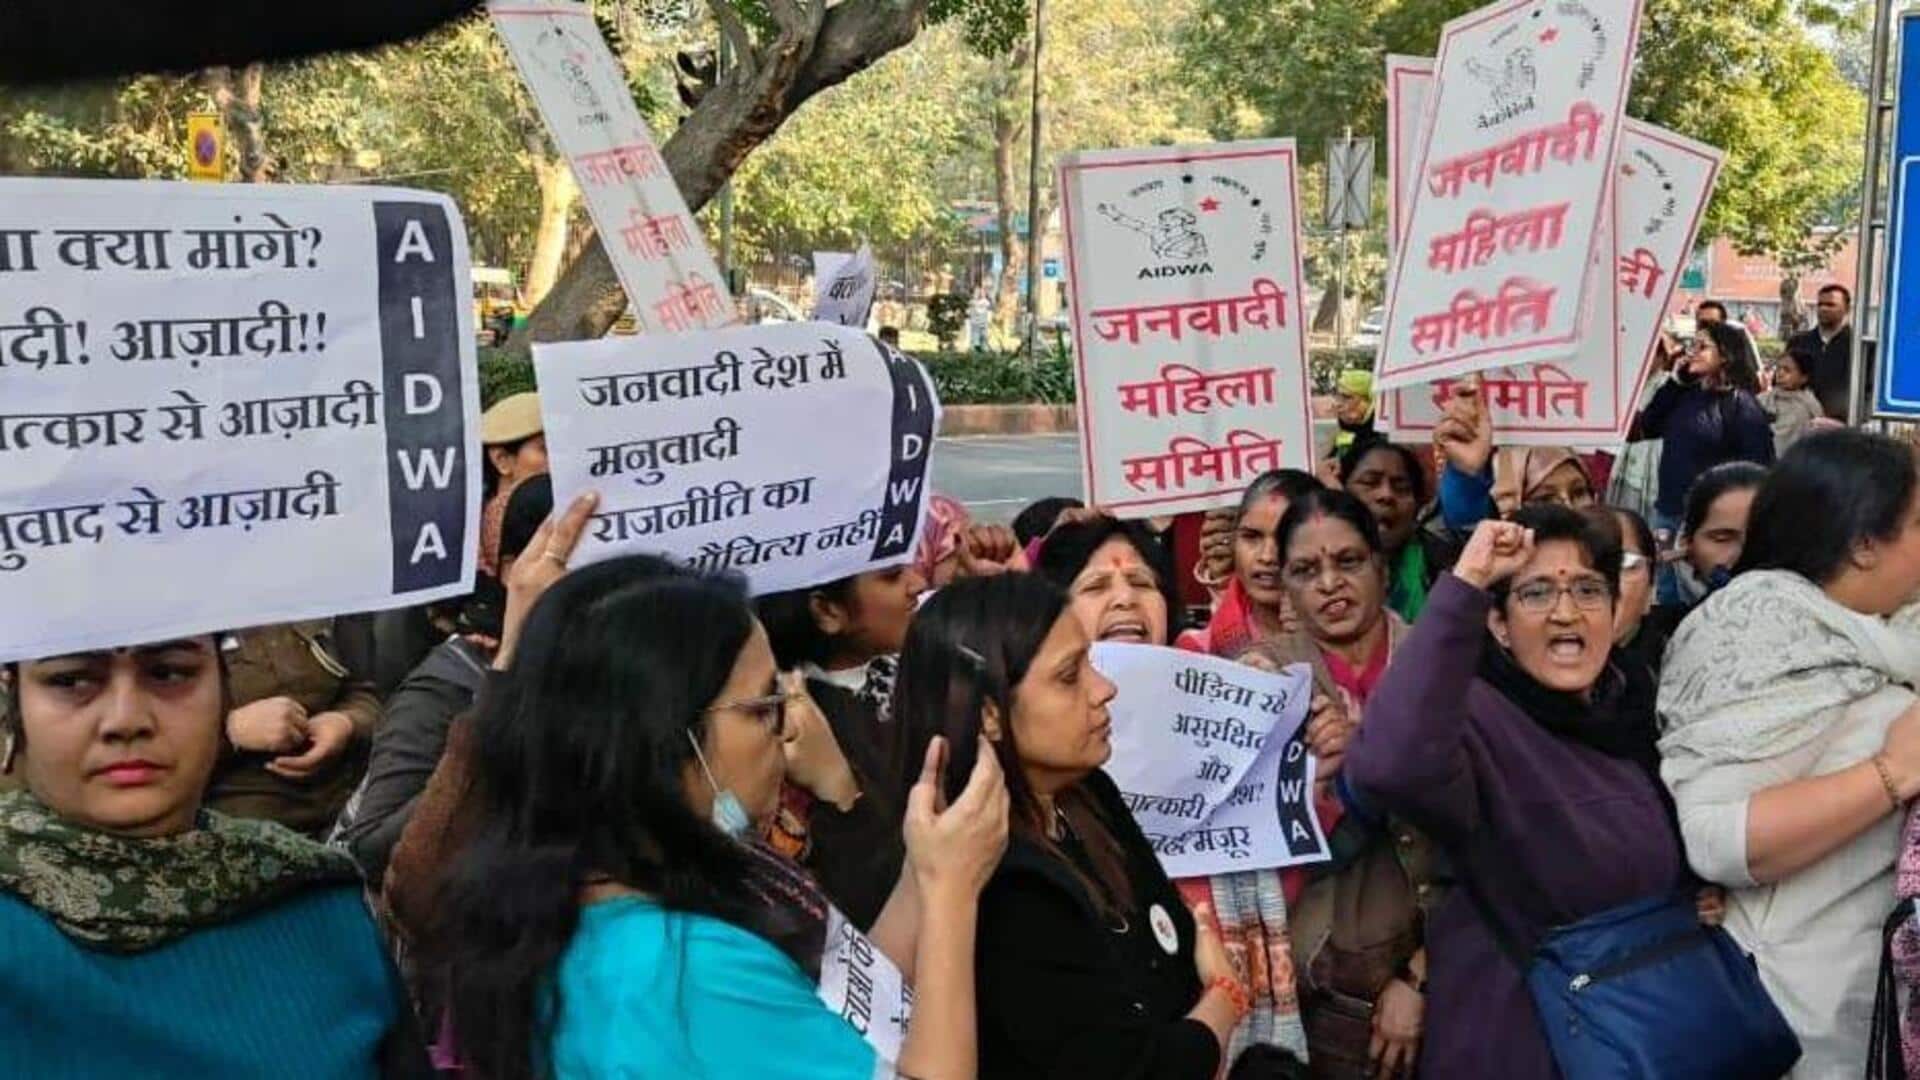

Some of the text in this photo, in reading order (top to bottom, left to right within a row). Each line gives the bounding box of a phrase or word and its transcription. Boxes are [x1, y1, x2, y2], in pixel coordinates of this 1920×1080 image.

[1427, 100, 1604, 198] जनवादी
[54, 229, 173, 271] क्या
[183, 213, 322, 270] मांगे?
[1137, 262, 1214, 280] AIDWA
[1427, 202, 1571, 274] महिला
[1091, 278, 1287, 344] जनवादी
[1410, 276, 1558, 355] समिति
[395, 219, 457, 565] AIDWA
[577, 340, 847, 408] जनवादी देश में
[1117, 364, 1276, 417] महिला
[158, 390, 207, 441] से
[218, 380, 382, 439] आज़ादी
[586, 417, 744, 487] मनुवादी
[1121, 429, 1283, 492] समिति
[116, 486, 165, 534] से
[175, 470, 343, 531] आज़ादी
[589, 475, 817, 545] राजनीति का
[817, 508, 884, 550] नहीं
